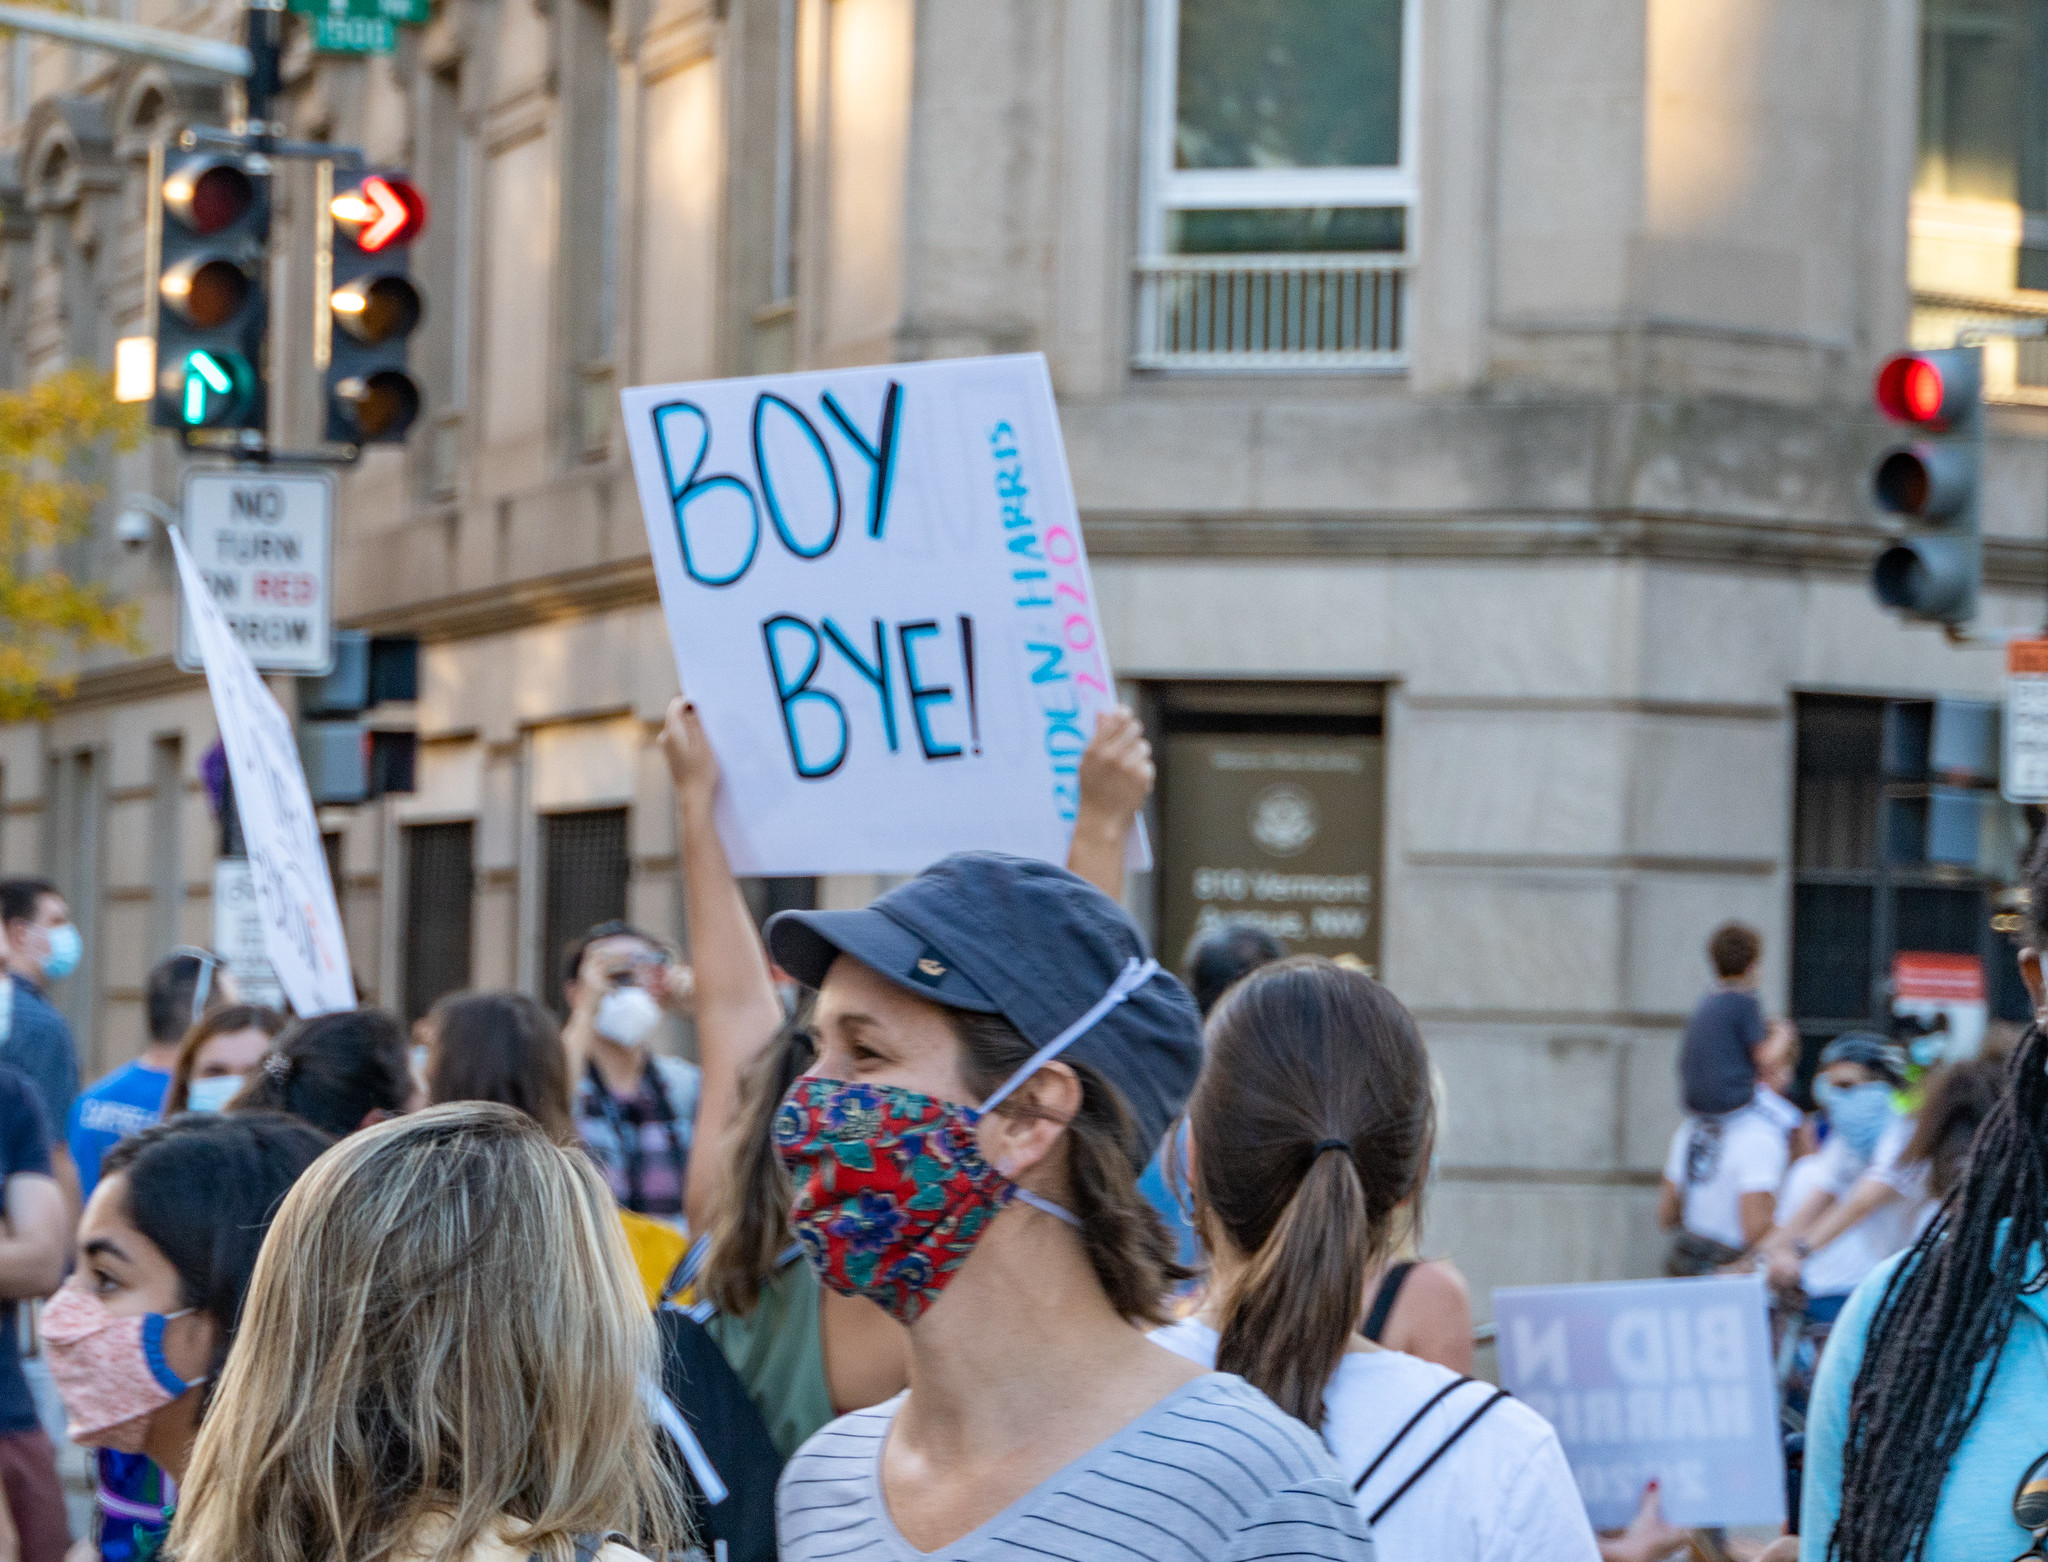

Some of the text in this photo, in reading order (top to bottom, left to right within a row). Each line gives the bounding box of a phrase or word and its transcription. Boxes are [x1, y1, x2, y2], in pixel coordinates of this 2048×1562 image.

[231, 486, 285, 524] NO
[650, 379, 905, 589] BOY
[985, 418, 1055, 608] HARRIS
[216, 530, 302, 565] TURN
[253, 570, 317, 606] RED
[225, 612, 313, 648] RROW
[1043, 523, 1107, 703] 2020
[760, 613, 981, 779] BYE!
